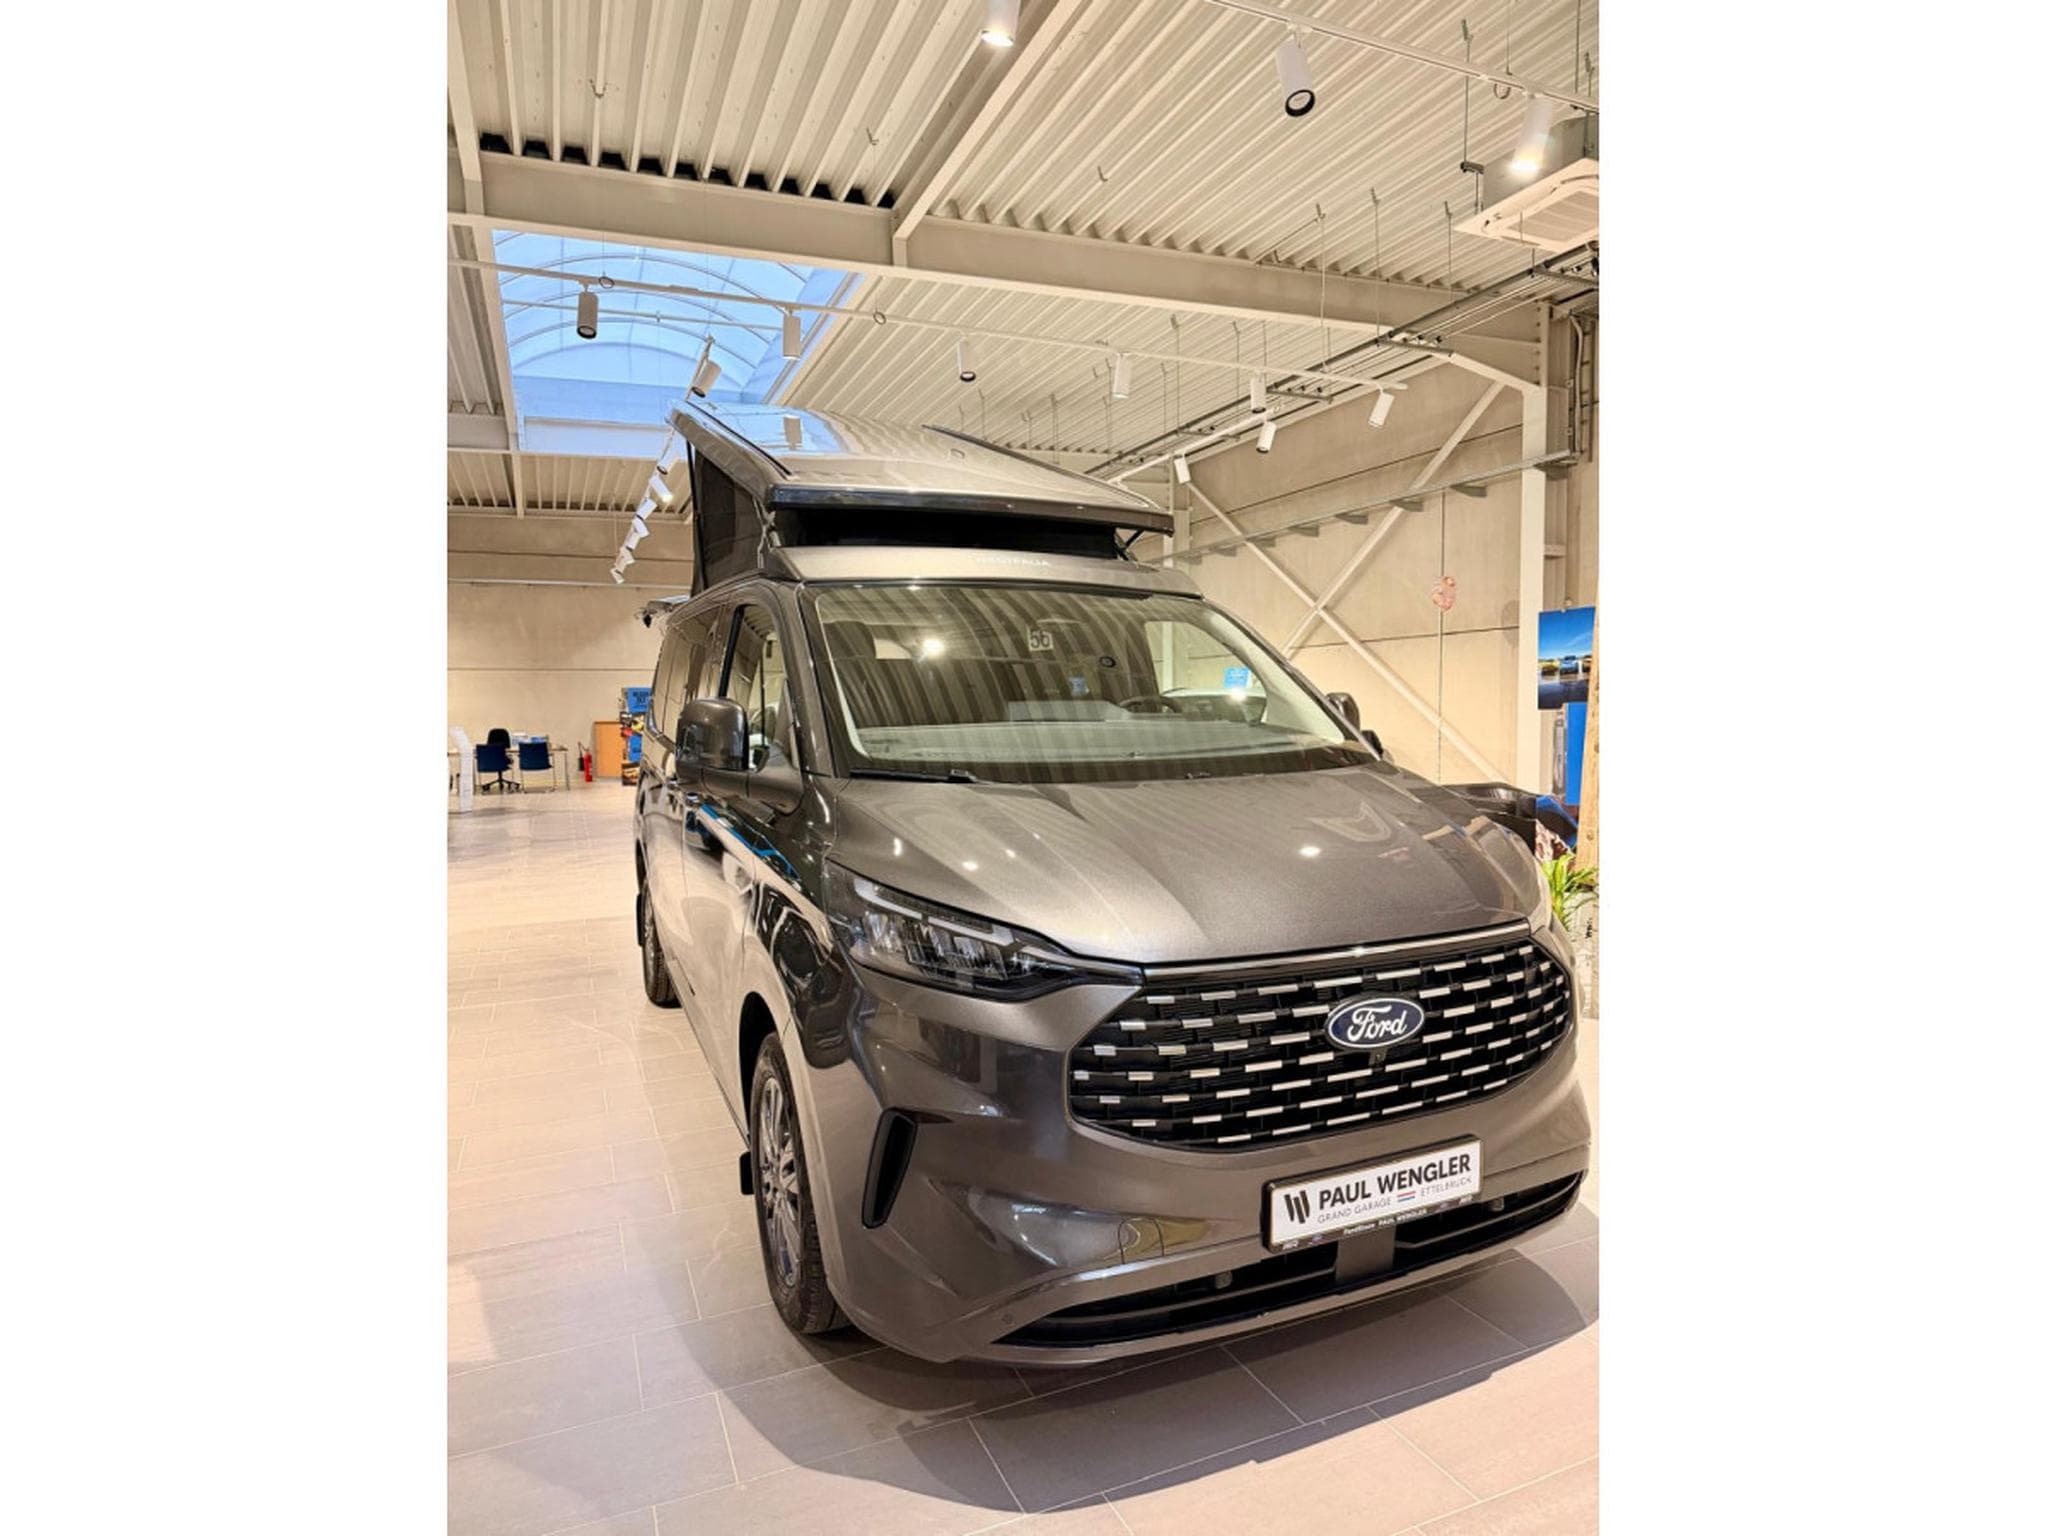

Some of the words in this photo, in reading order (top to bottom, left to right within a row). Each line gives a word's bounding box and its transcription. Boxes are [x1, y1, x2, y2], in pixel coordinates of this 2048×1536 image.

[1347, 1005, 1408, 1042] Ford
[1318, 1180, 1372, 1210] PAUL
[1377, 1153, 1471, 1194] WENGLER
[1317, 1207, 1352, 1224] GRAND
[1354, 1197, 1392, 1214] GARAGE
